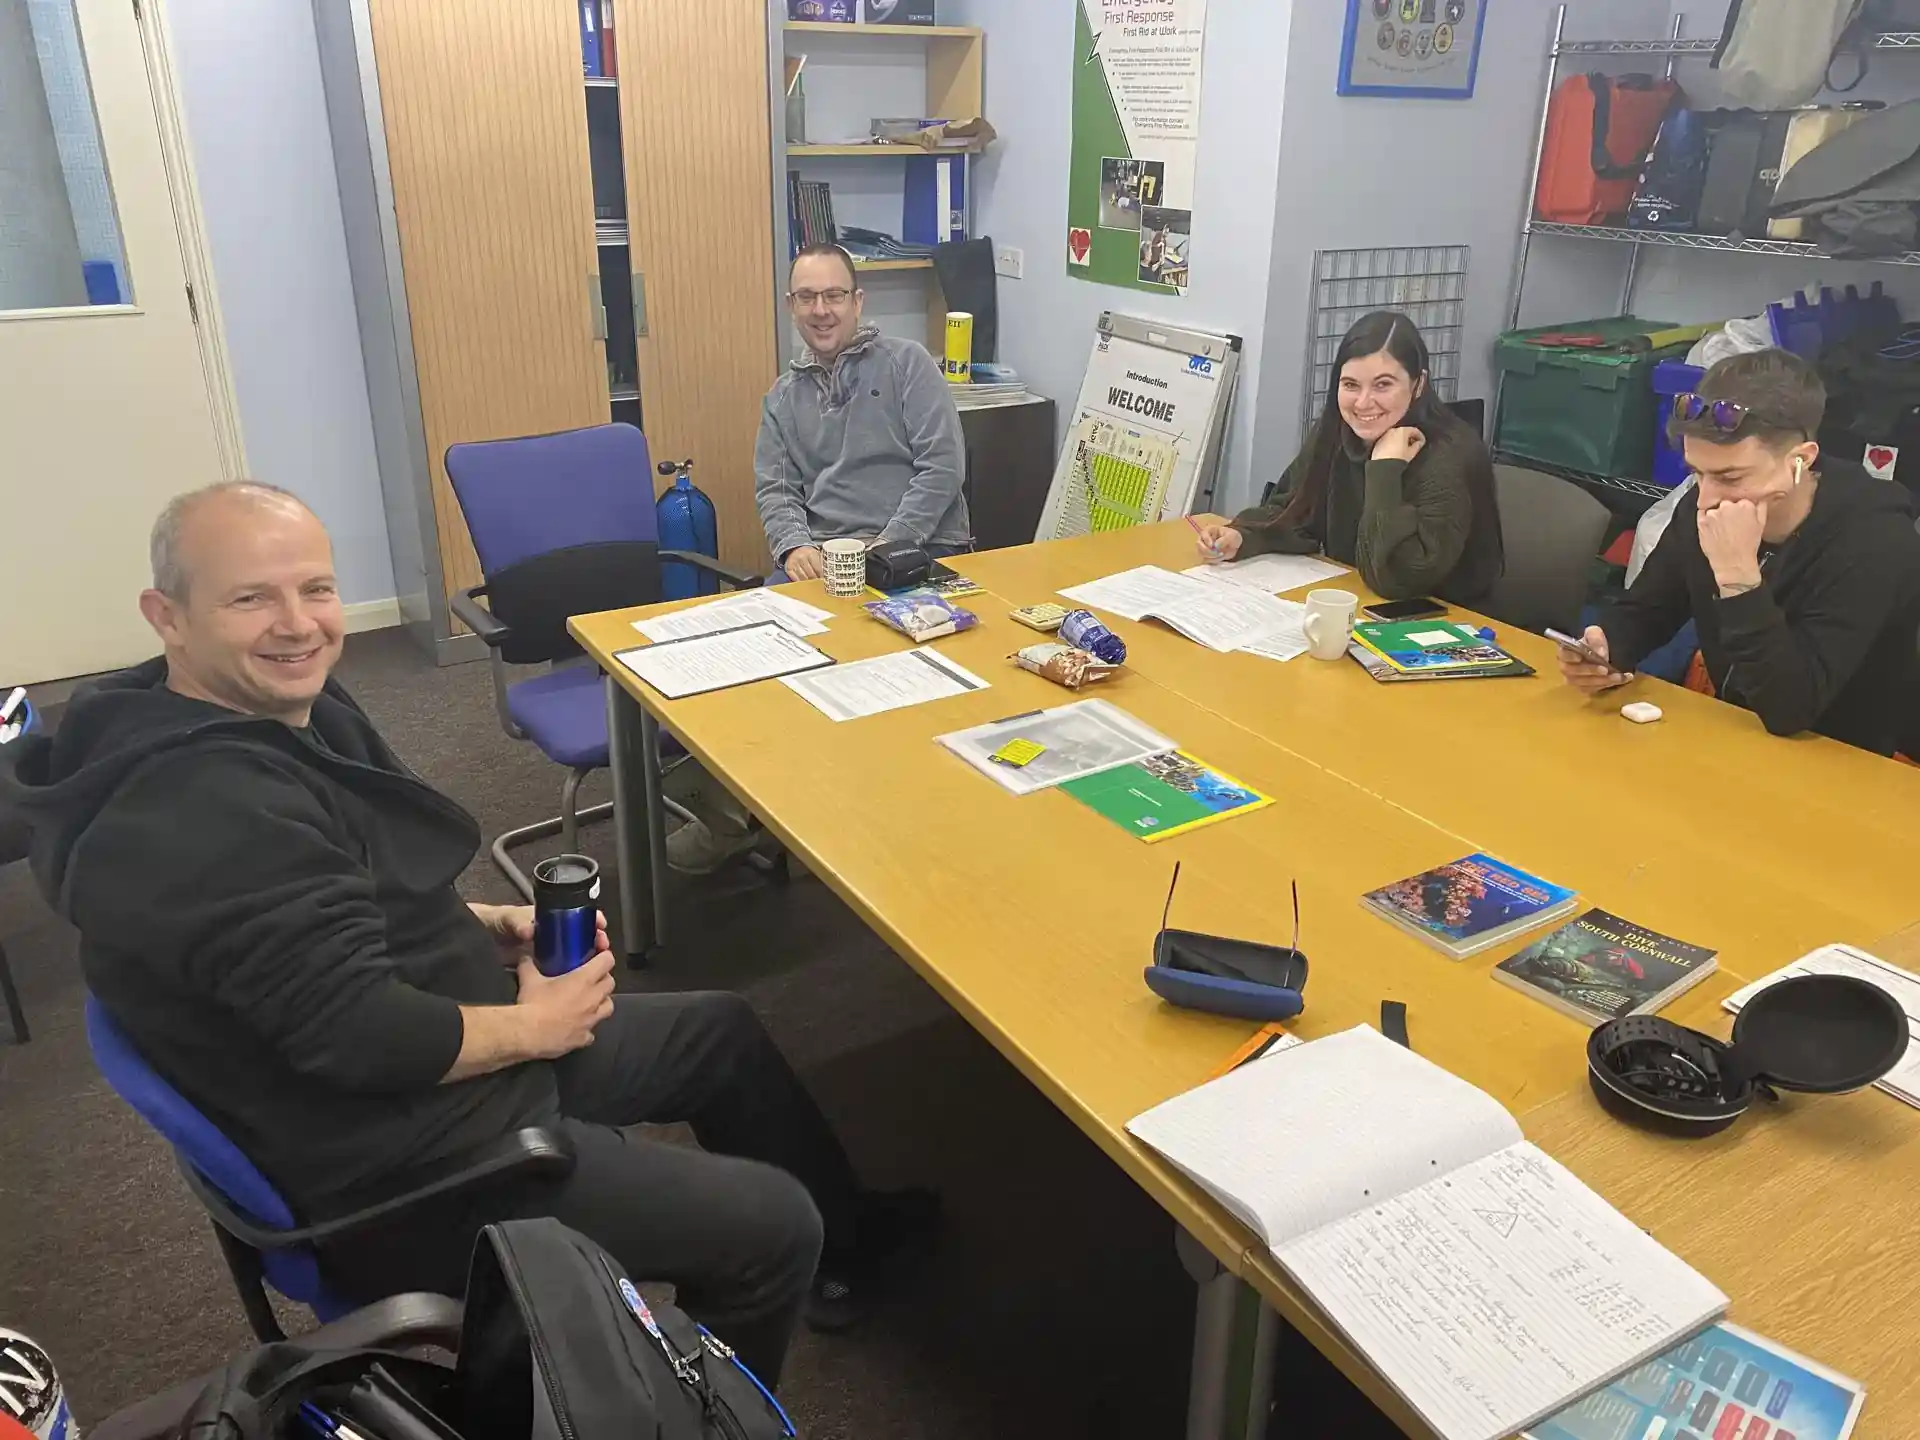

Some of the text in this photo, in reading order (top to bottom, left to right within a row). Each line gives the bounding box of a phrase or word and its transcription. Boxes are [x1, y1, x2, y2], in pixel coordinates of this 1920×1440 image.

[1104, 10, 1174, 24] First Response
[1123, 27, 1137, 37] First
[1138, 27, 1150, 36] Aid
[1151, 28, 1158, 36] at
[1159, 26, 1177, 36] Work
[1126, 370, 1168, 389] Introduction
[1107, 386, 1176, 423] WELCOME
[1576, 920, 1692, 967] SOUTH CORNWALL
[1623, 932, 1660, 948] DIVE
